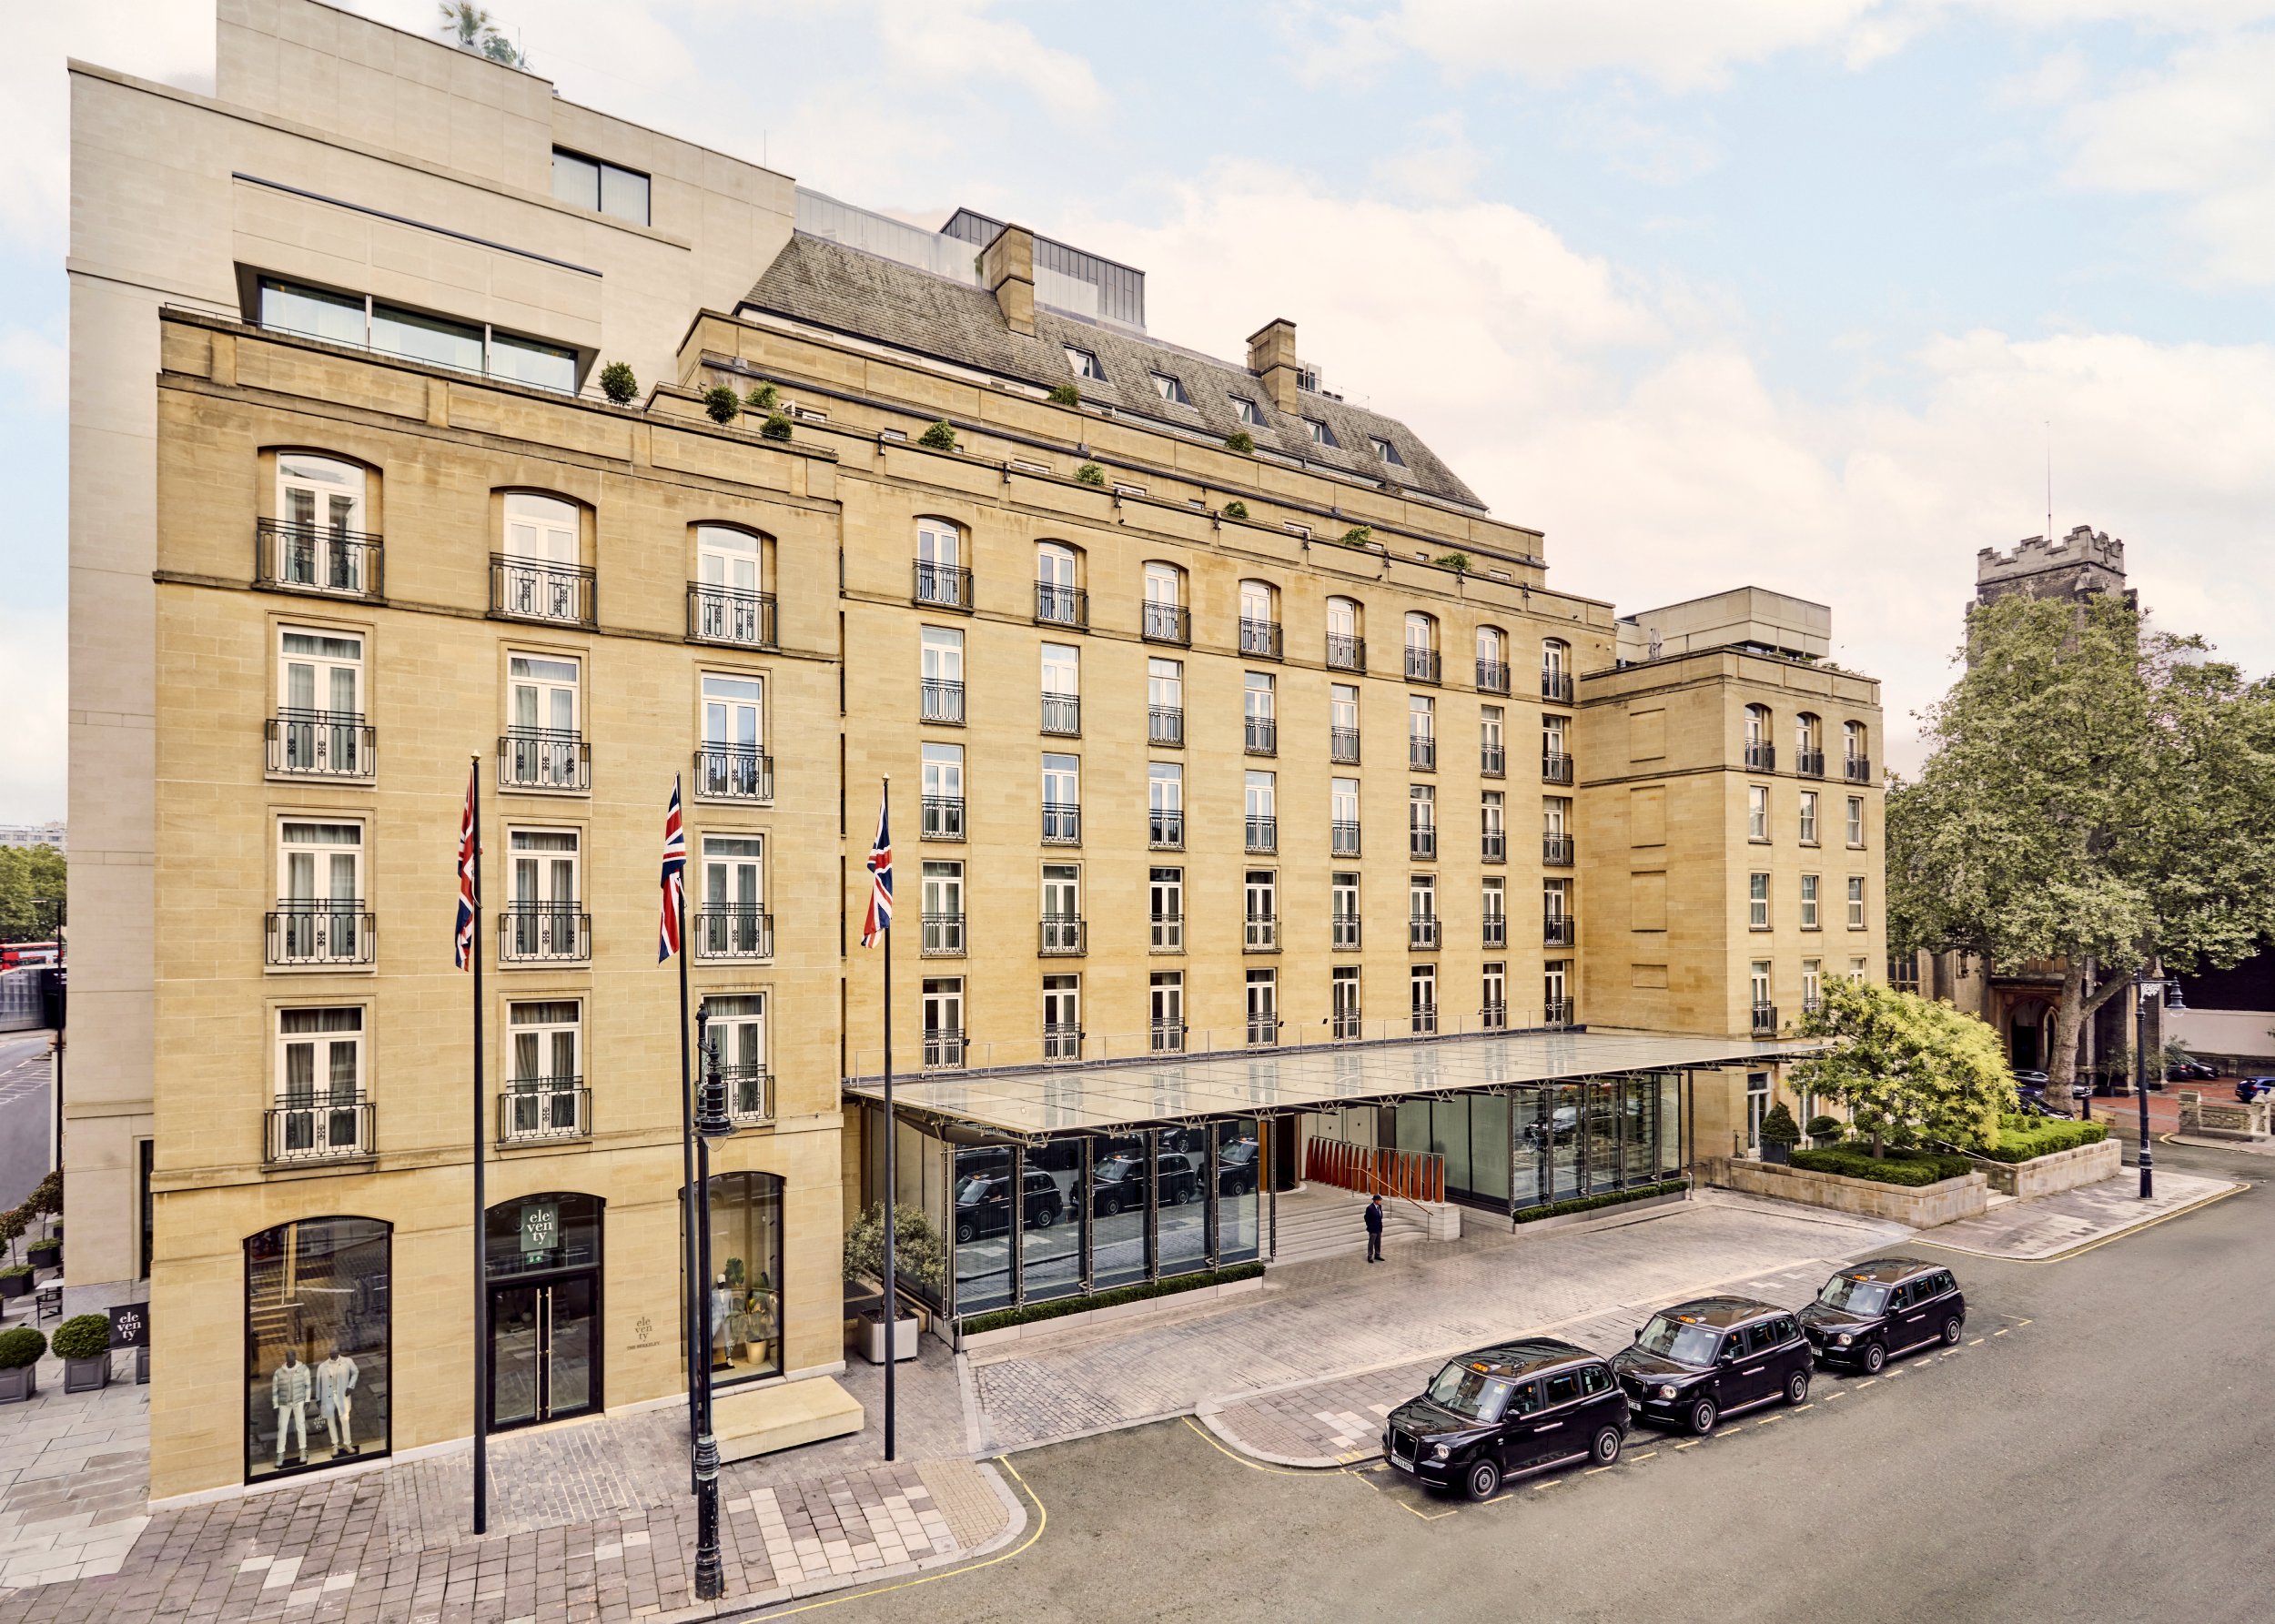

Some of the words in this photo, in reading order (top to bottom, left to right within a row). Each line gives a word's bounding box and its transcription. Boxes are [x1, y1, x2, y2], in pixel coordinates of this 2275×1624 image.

[530, 1209, 550, 1223] ele
[527, 1222, 552, 1233] ven
[532, 1231, 547, 1245] ty
[119, 1311, 139, 1324] ele
[636, 1316, 651, 1326] ele
[116, 1321, 142, 1332] ven
[122, 1329, 136, 1341] ty
[639, 1332, 649, 1342] ty
